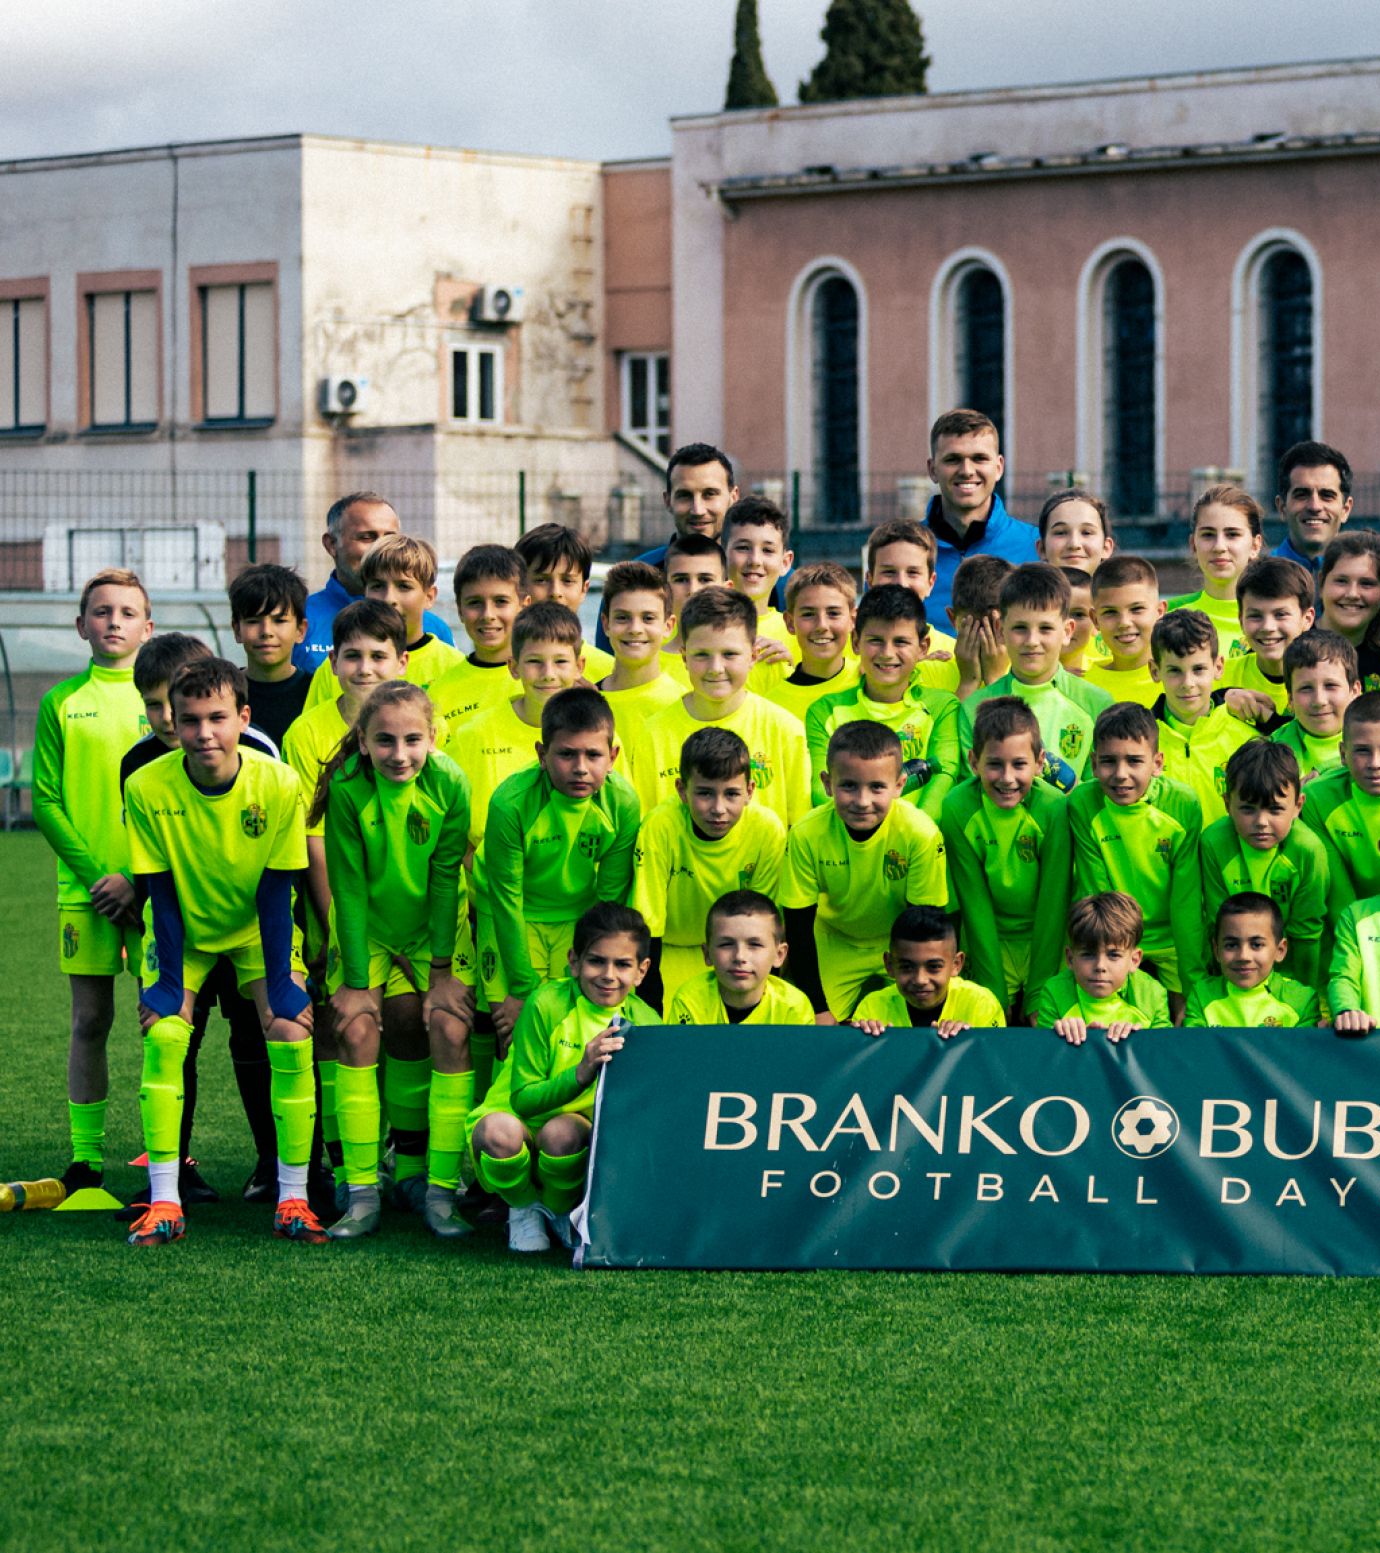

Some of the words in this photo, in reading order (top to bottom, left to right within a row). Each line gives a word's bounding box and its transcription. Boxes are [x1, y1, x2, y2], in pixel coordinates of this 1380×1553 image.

[67, 711, 99, 720] KELME
[443, 702, 480, 720] KELME
[703, 1091, 1091, 1156] BRANKO
[760, 1169, 1159, 1204] FOOTBALL
